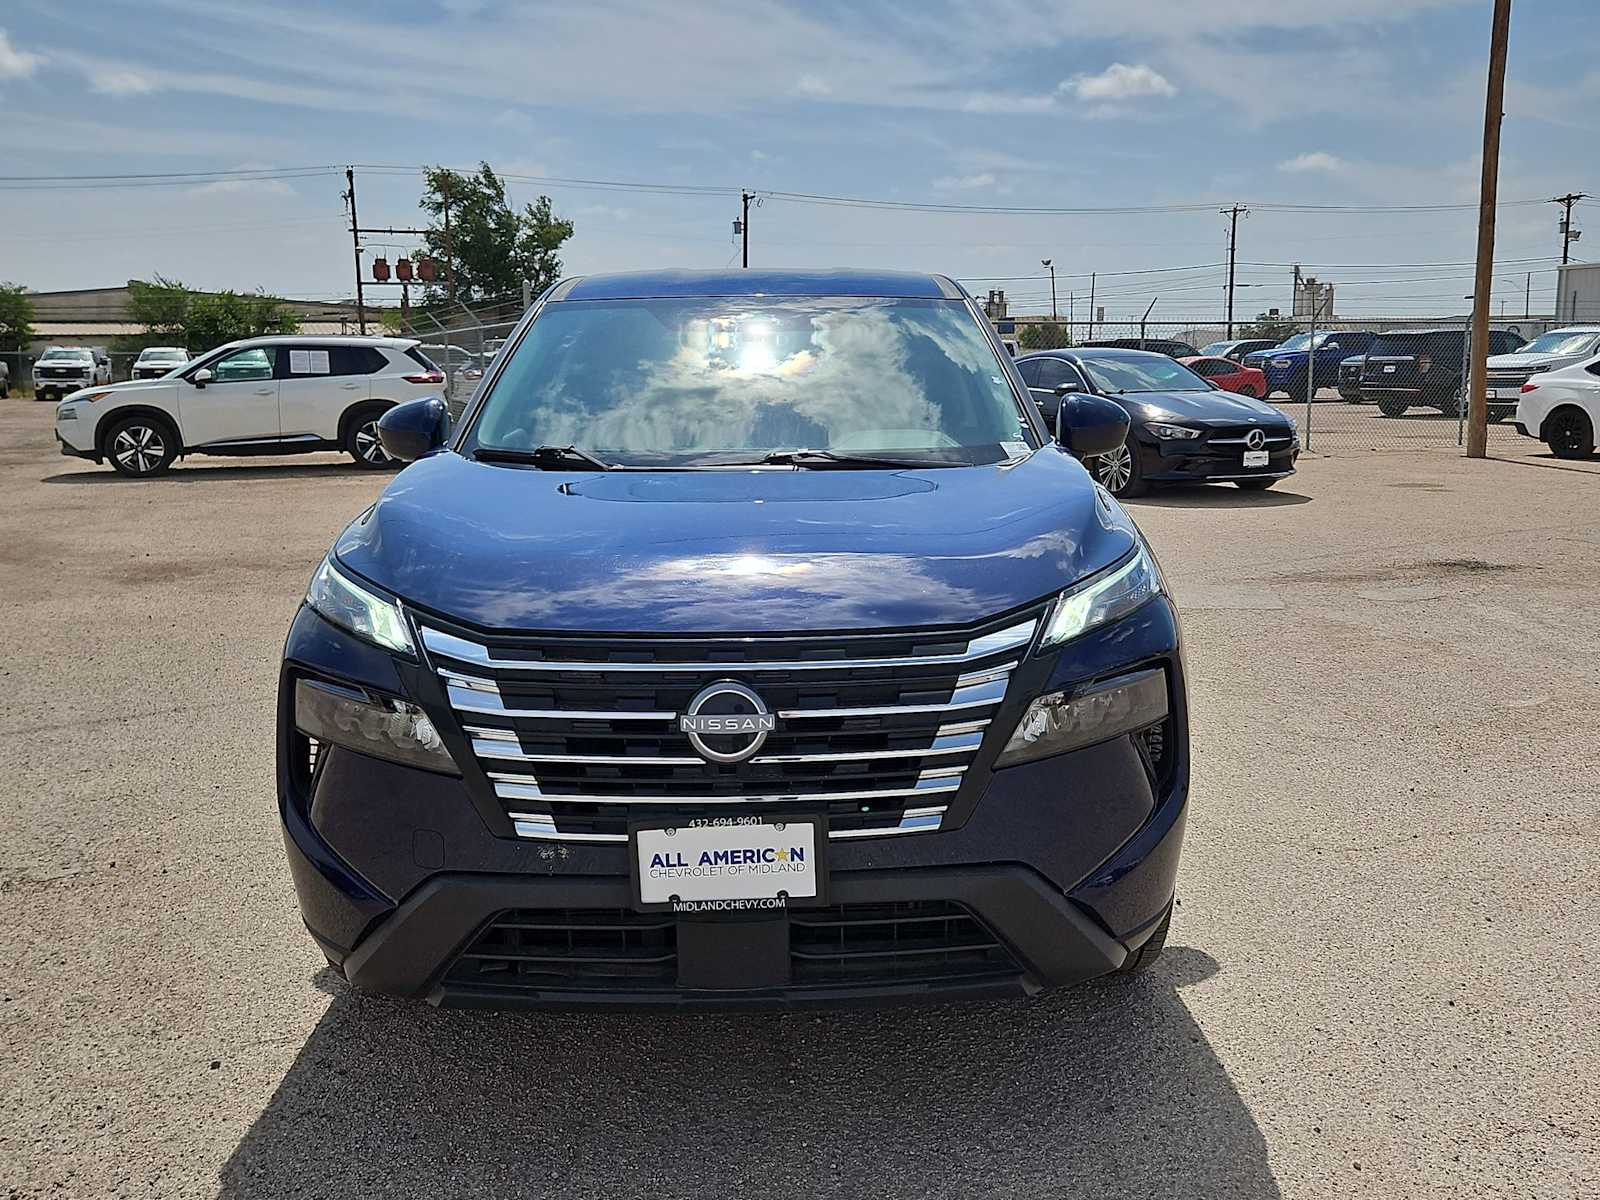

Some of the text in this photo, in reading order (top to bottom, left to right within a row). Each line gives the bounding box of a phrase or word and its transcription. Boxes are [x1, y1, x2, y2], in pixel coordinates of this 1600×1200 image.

[683, 717, 773, 730] NISSAN
[688, 816, 763, 827] 432-694-9601
[650, 852, 688, 868] ALL
[650, 862, 806, 879] CHEVROLET OF MIDLAND
[673, 898, 786, 912] MIDLANDCHEVY.COM
